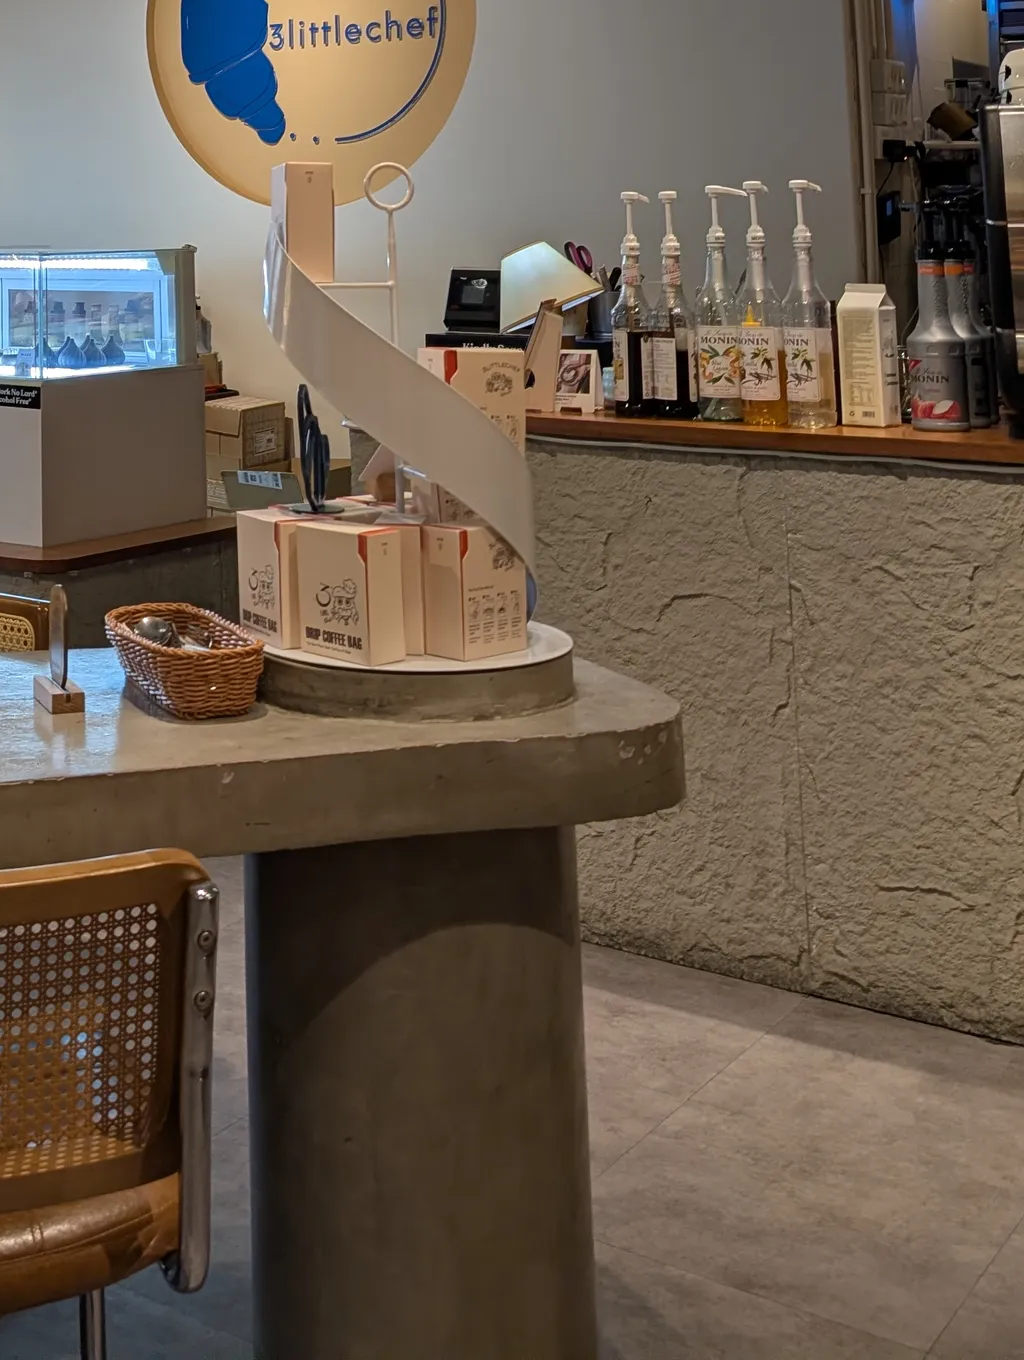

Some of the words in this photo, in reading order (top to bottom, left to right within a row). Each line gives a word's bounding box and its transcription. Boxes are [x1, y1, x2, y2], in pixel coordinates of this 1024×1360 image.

[269, 6, 438, 51] 3littlechef
[11, 388, 21, 396] No
[322, 629, 347, 647] COFFEE
